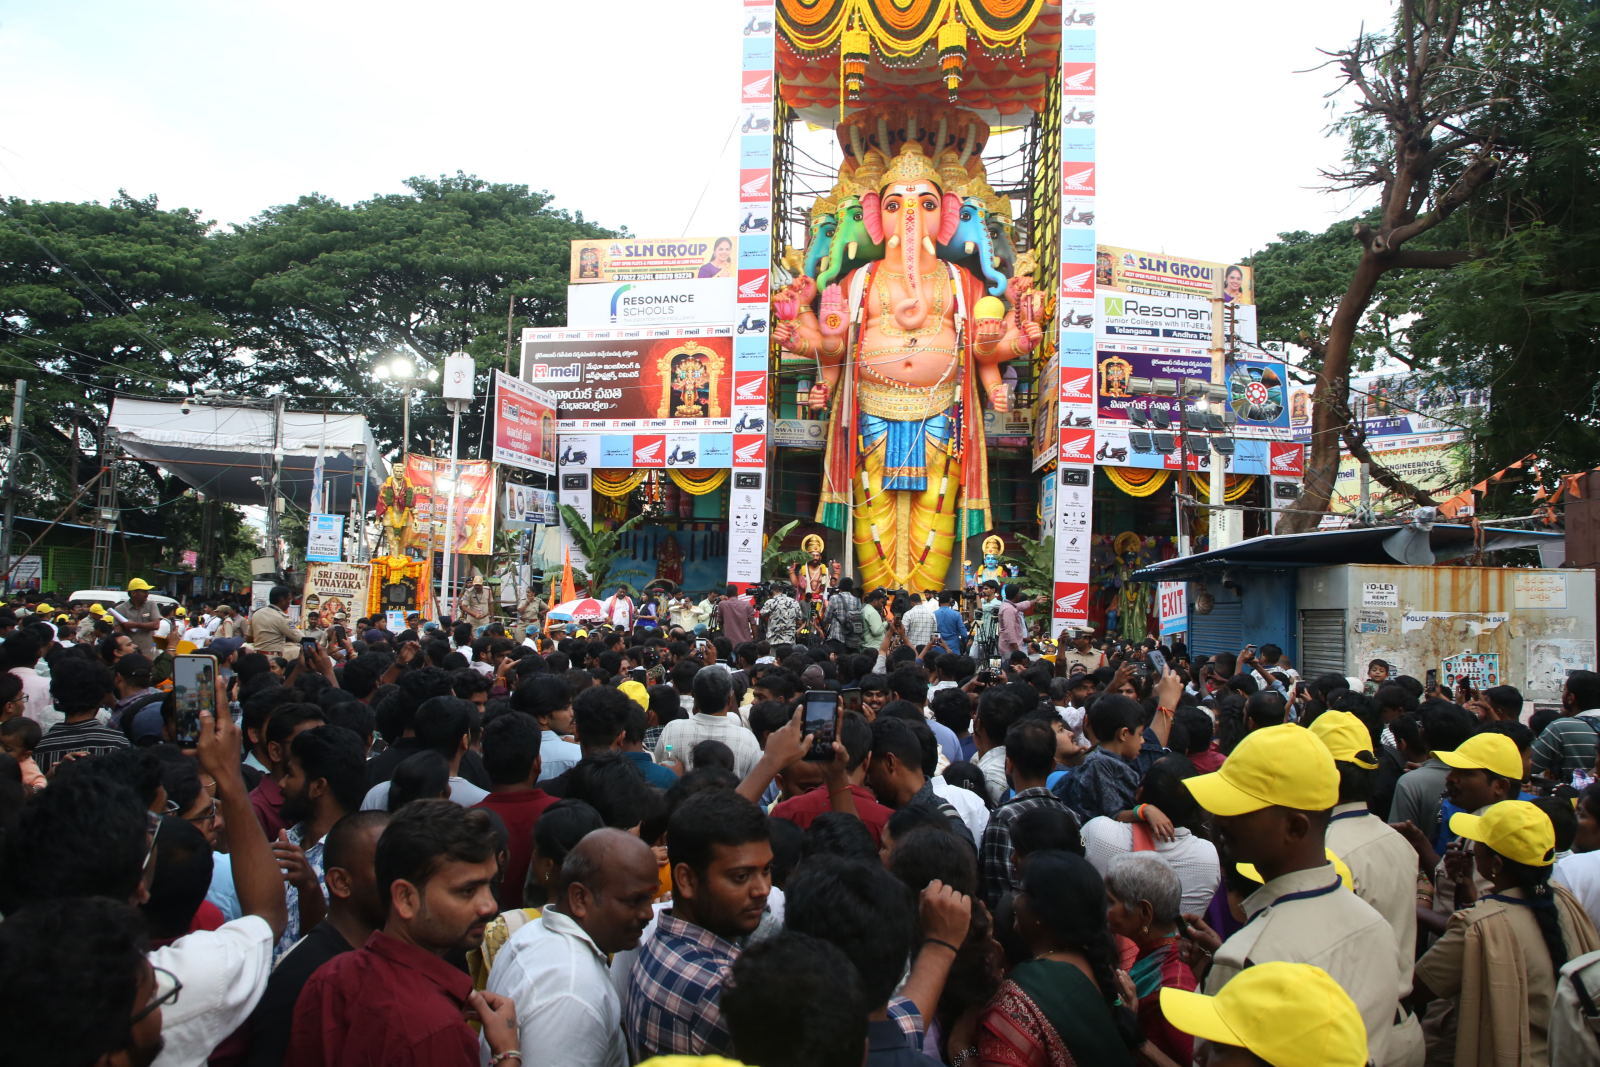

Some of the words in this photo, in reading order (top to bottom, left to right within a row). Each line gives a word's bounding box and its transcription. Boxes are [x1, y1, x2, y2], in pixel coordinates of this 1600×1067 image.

[625, 245, 654, 257] SLN
[656, 244, 708, 258] GROUP
[1139, 257, 1167, 273] SLN
[1170, 262, 1212, 280] GROU
[624, 294, 694, 305] RESONANCE
[624, 306, 674, 316] SCHOOLS
[1125, 300, 1231, 323] Resonane
[1131, 318, 1162, 326] Colleges
[1114, 326, 1152, 336] Telangana
[1172, 331, 1198, 340] Andhra
[550, 365, 579, 377] meil
[1337, 469, 1354, 478] meil
[318, 571, 333, 579] SRI
[334, 571, 358, 580] SIDDI
[314, 578, 361, 590] VINAYAKA
[1162, 589, 1183, 617] EXIT
